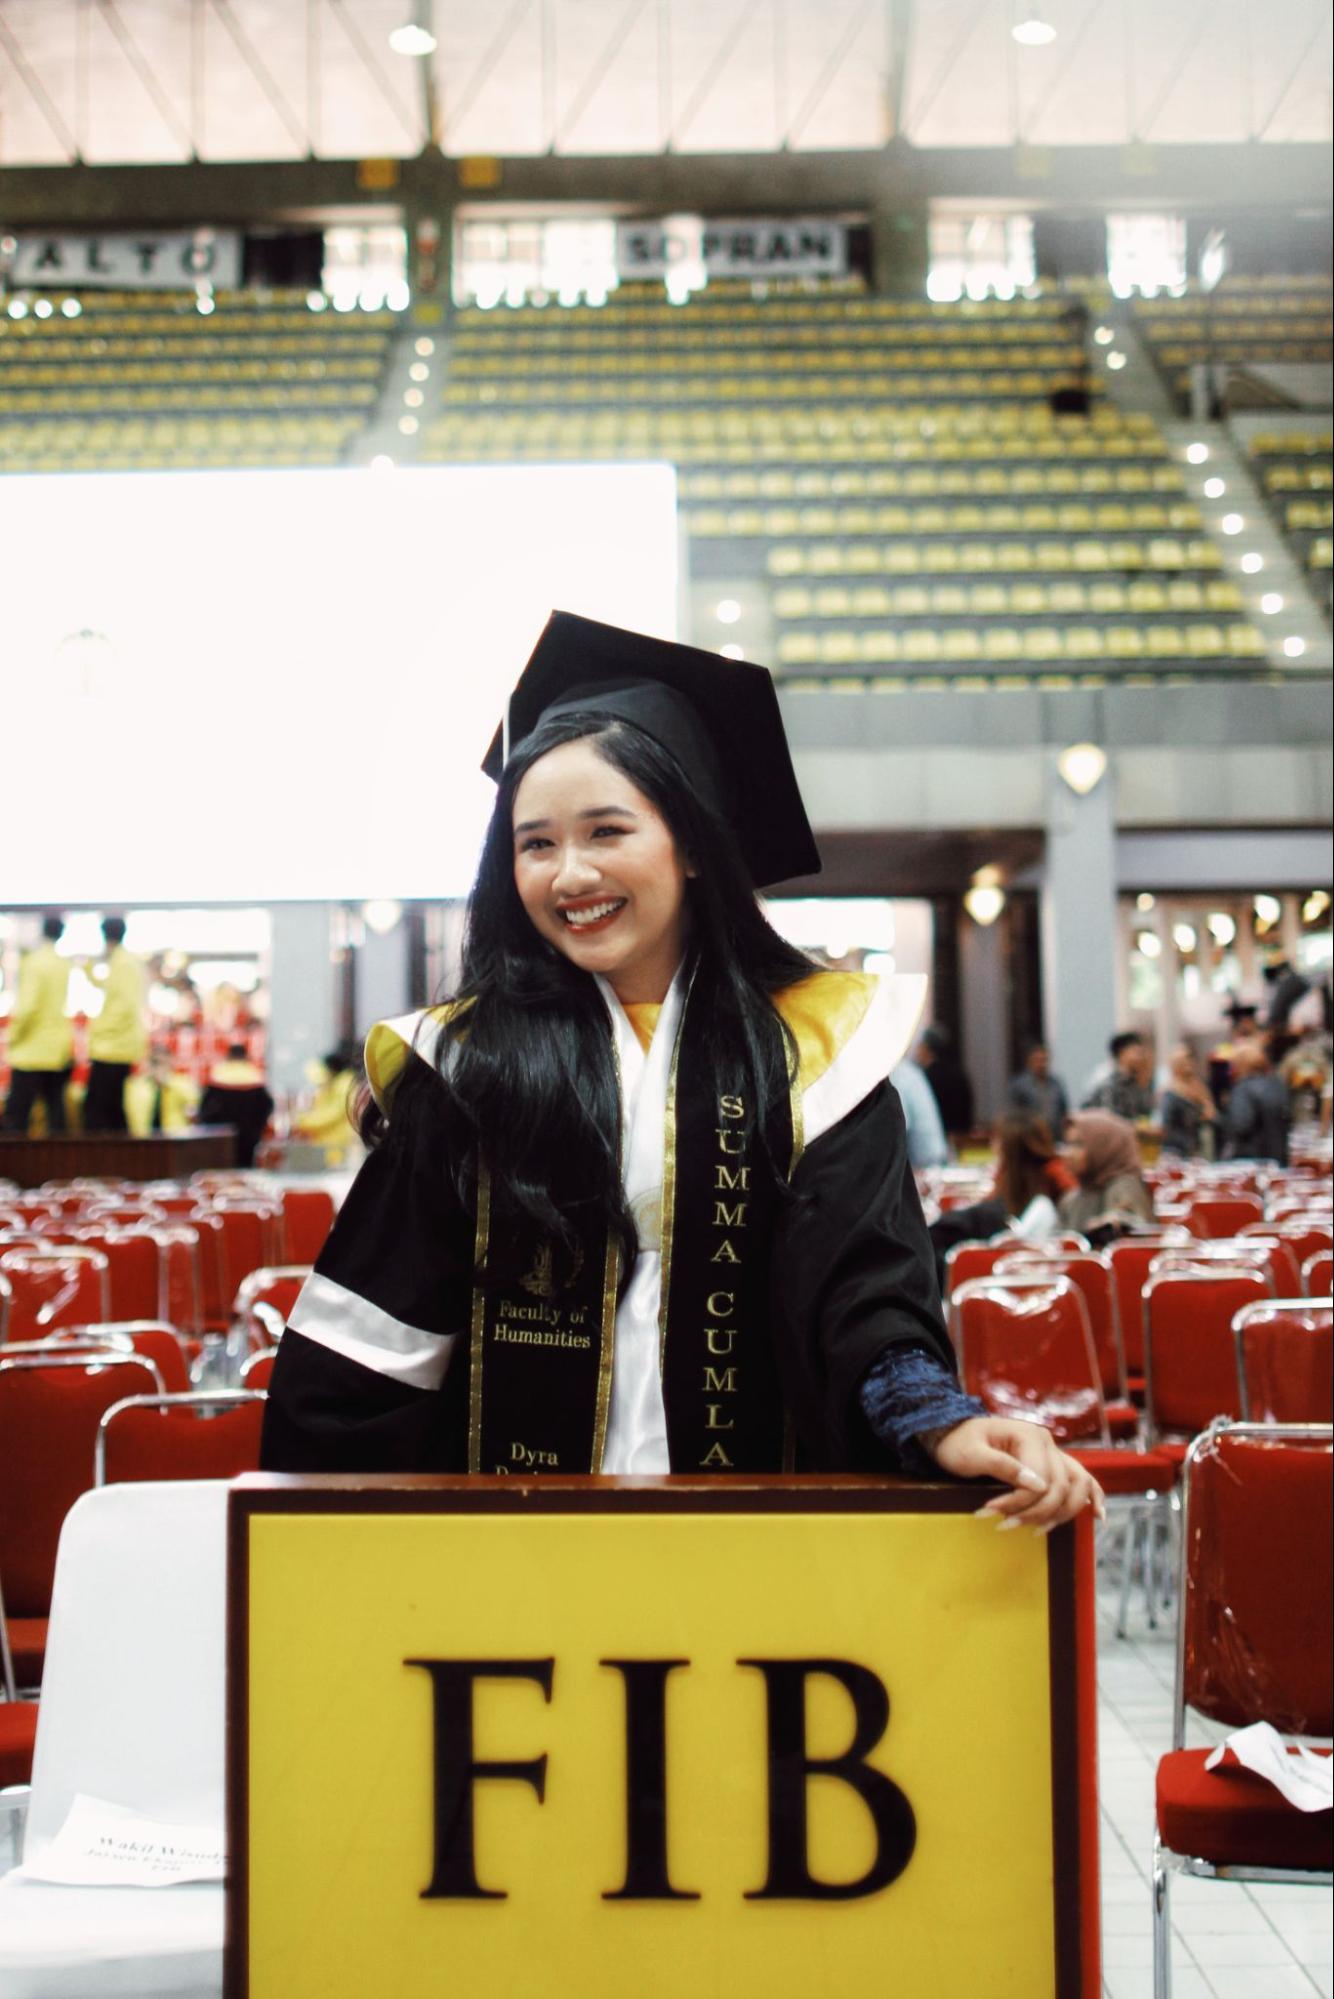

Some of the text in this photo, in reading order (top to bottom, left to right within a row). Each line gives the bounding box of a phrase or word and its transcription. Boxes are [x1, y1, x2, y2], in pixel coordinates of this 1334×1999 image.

[34, 237, 216, 277] ALTO
[712, 1094, 751, 1264] SUMMA
[499, 1299, 588, 1327] Faculty of
[493, 1323, 592, 1349] Humanities
[510, 1441, 560, 1467] Dyra
[402, 1657, 917, 1901] FIB
